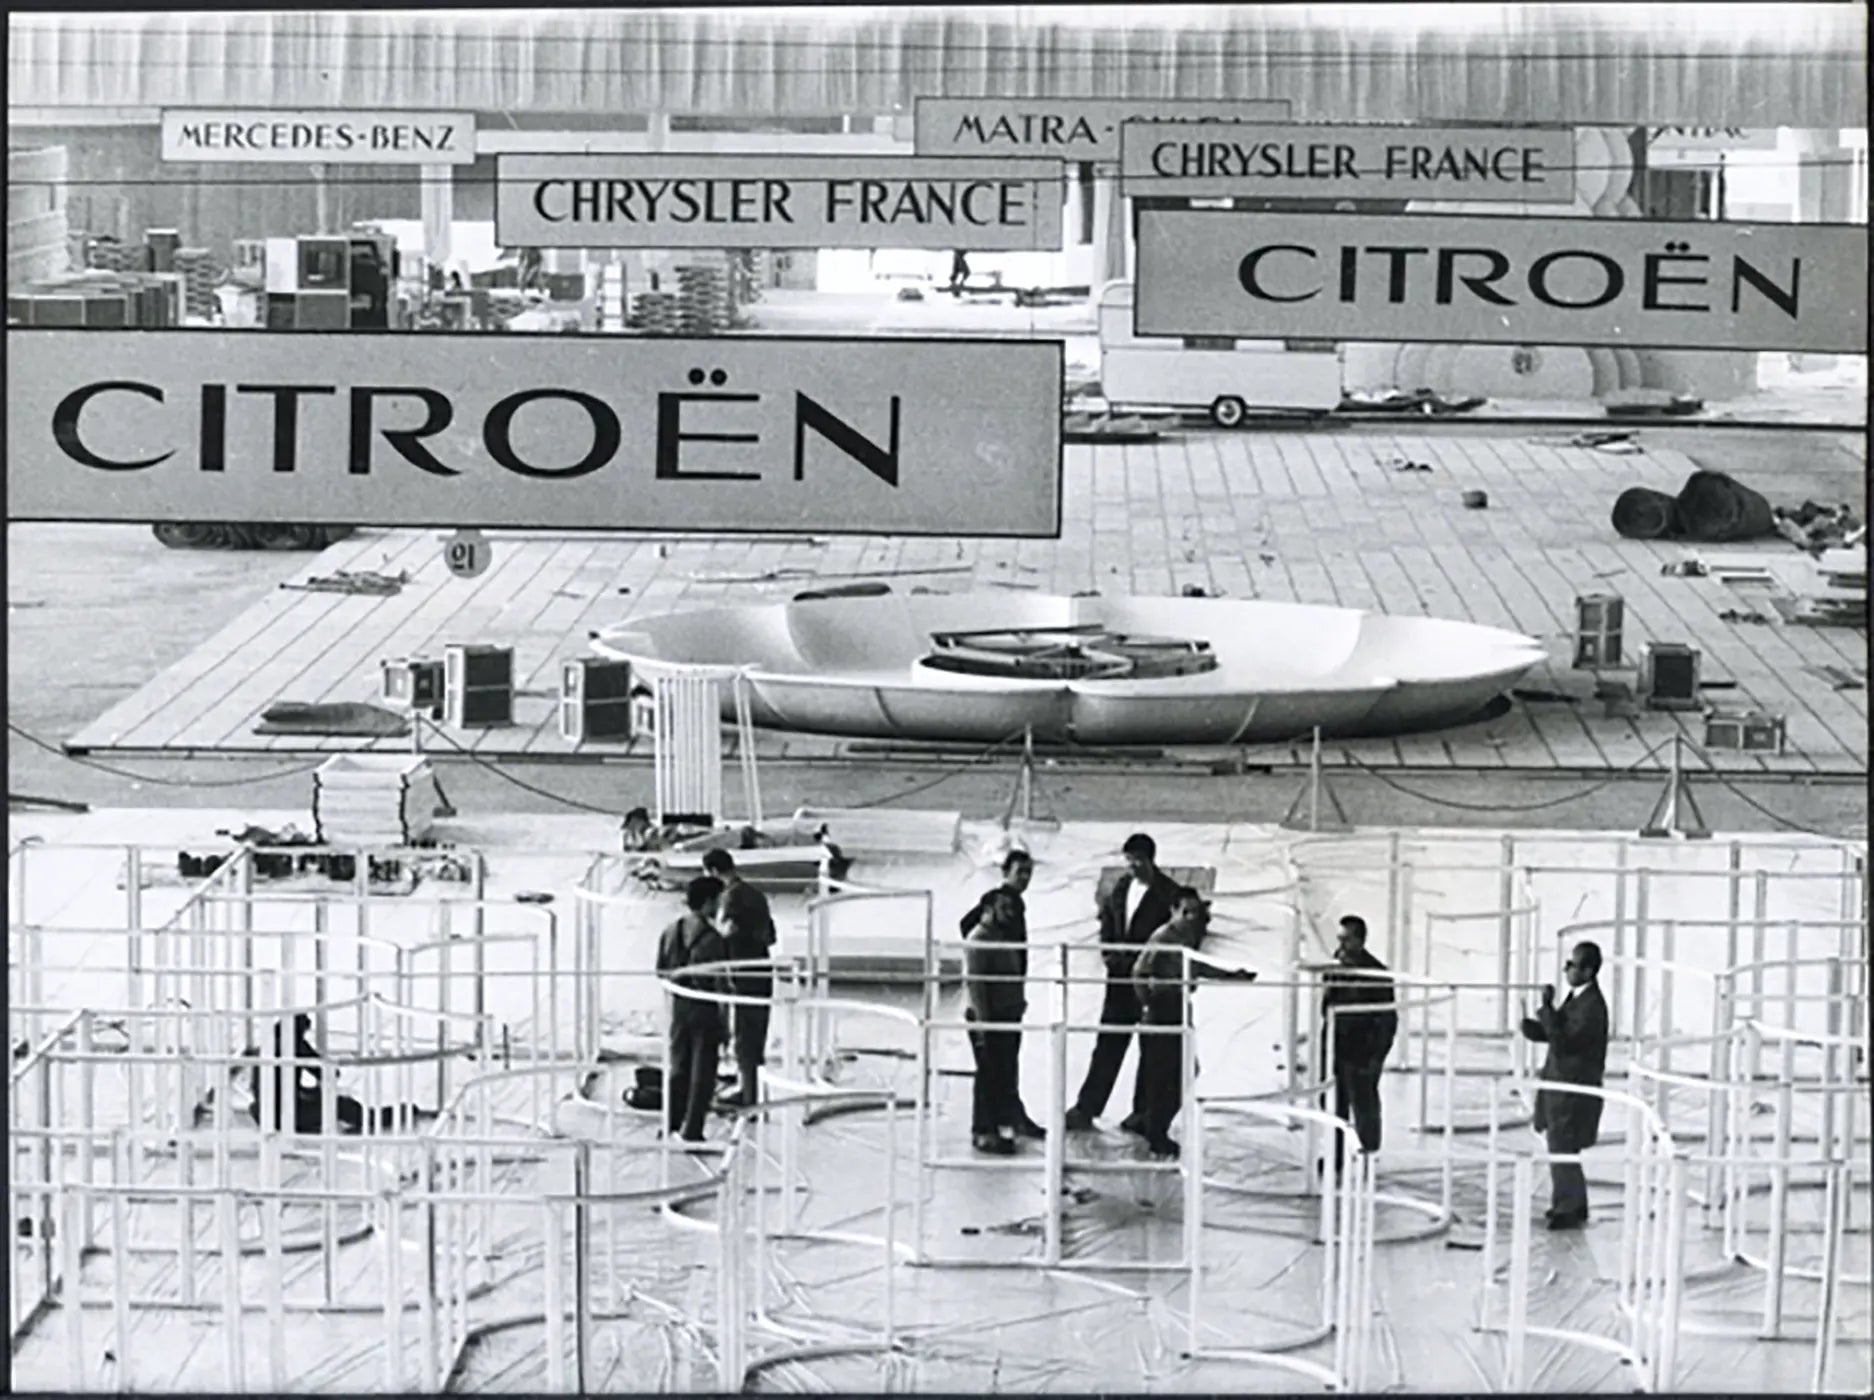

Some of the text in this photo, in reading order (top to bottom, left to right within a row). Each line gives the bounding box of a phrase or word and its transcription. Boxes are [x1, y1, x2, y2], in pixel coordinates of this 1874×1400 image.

[177, 123, 457, 152] MERCEDES-BENZ
[1151, 141, 1547, 183] CHRYSLER FRANCE
[532, 179, 1027, 226] CHRYSLER FRANCE
[1238, 241, 1801, 319] CITROËN
[52, 367, 901, 488] CITROËN
